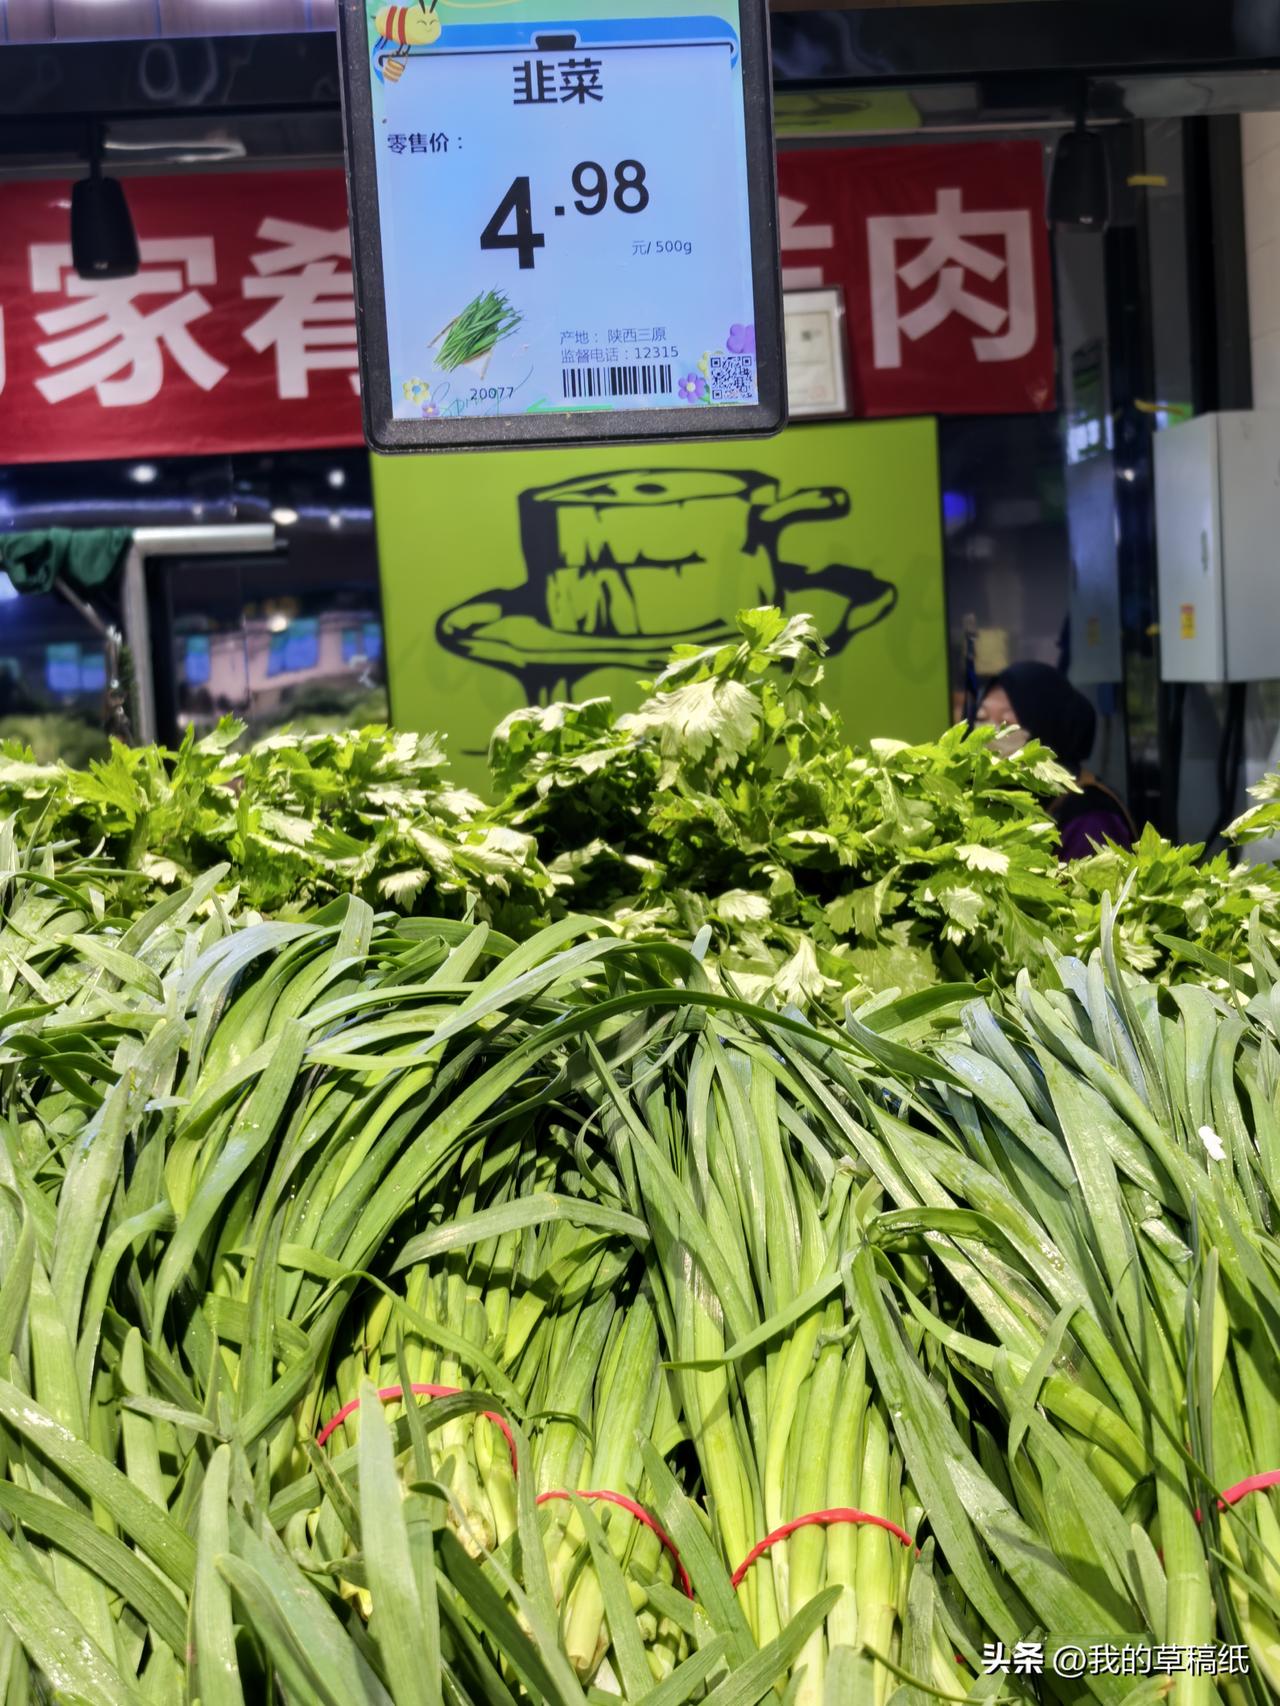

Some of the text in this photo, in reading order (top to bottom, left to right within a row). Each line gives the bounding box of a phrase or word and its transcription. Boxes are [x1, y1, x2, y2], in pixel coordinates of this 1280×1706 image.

[512, 57, 604, 105] 韭菜
[0, 217, 360, 407] 家肴
[470, 386, 514, 401] 20077
